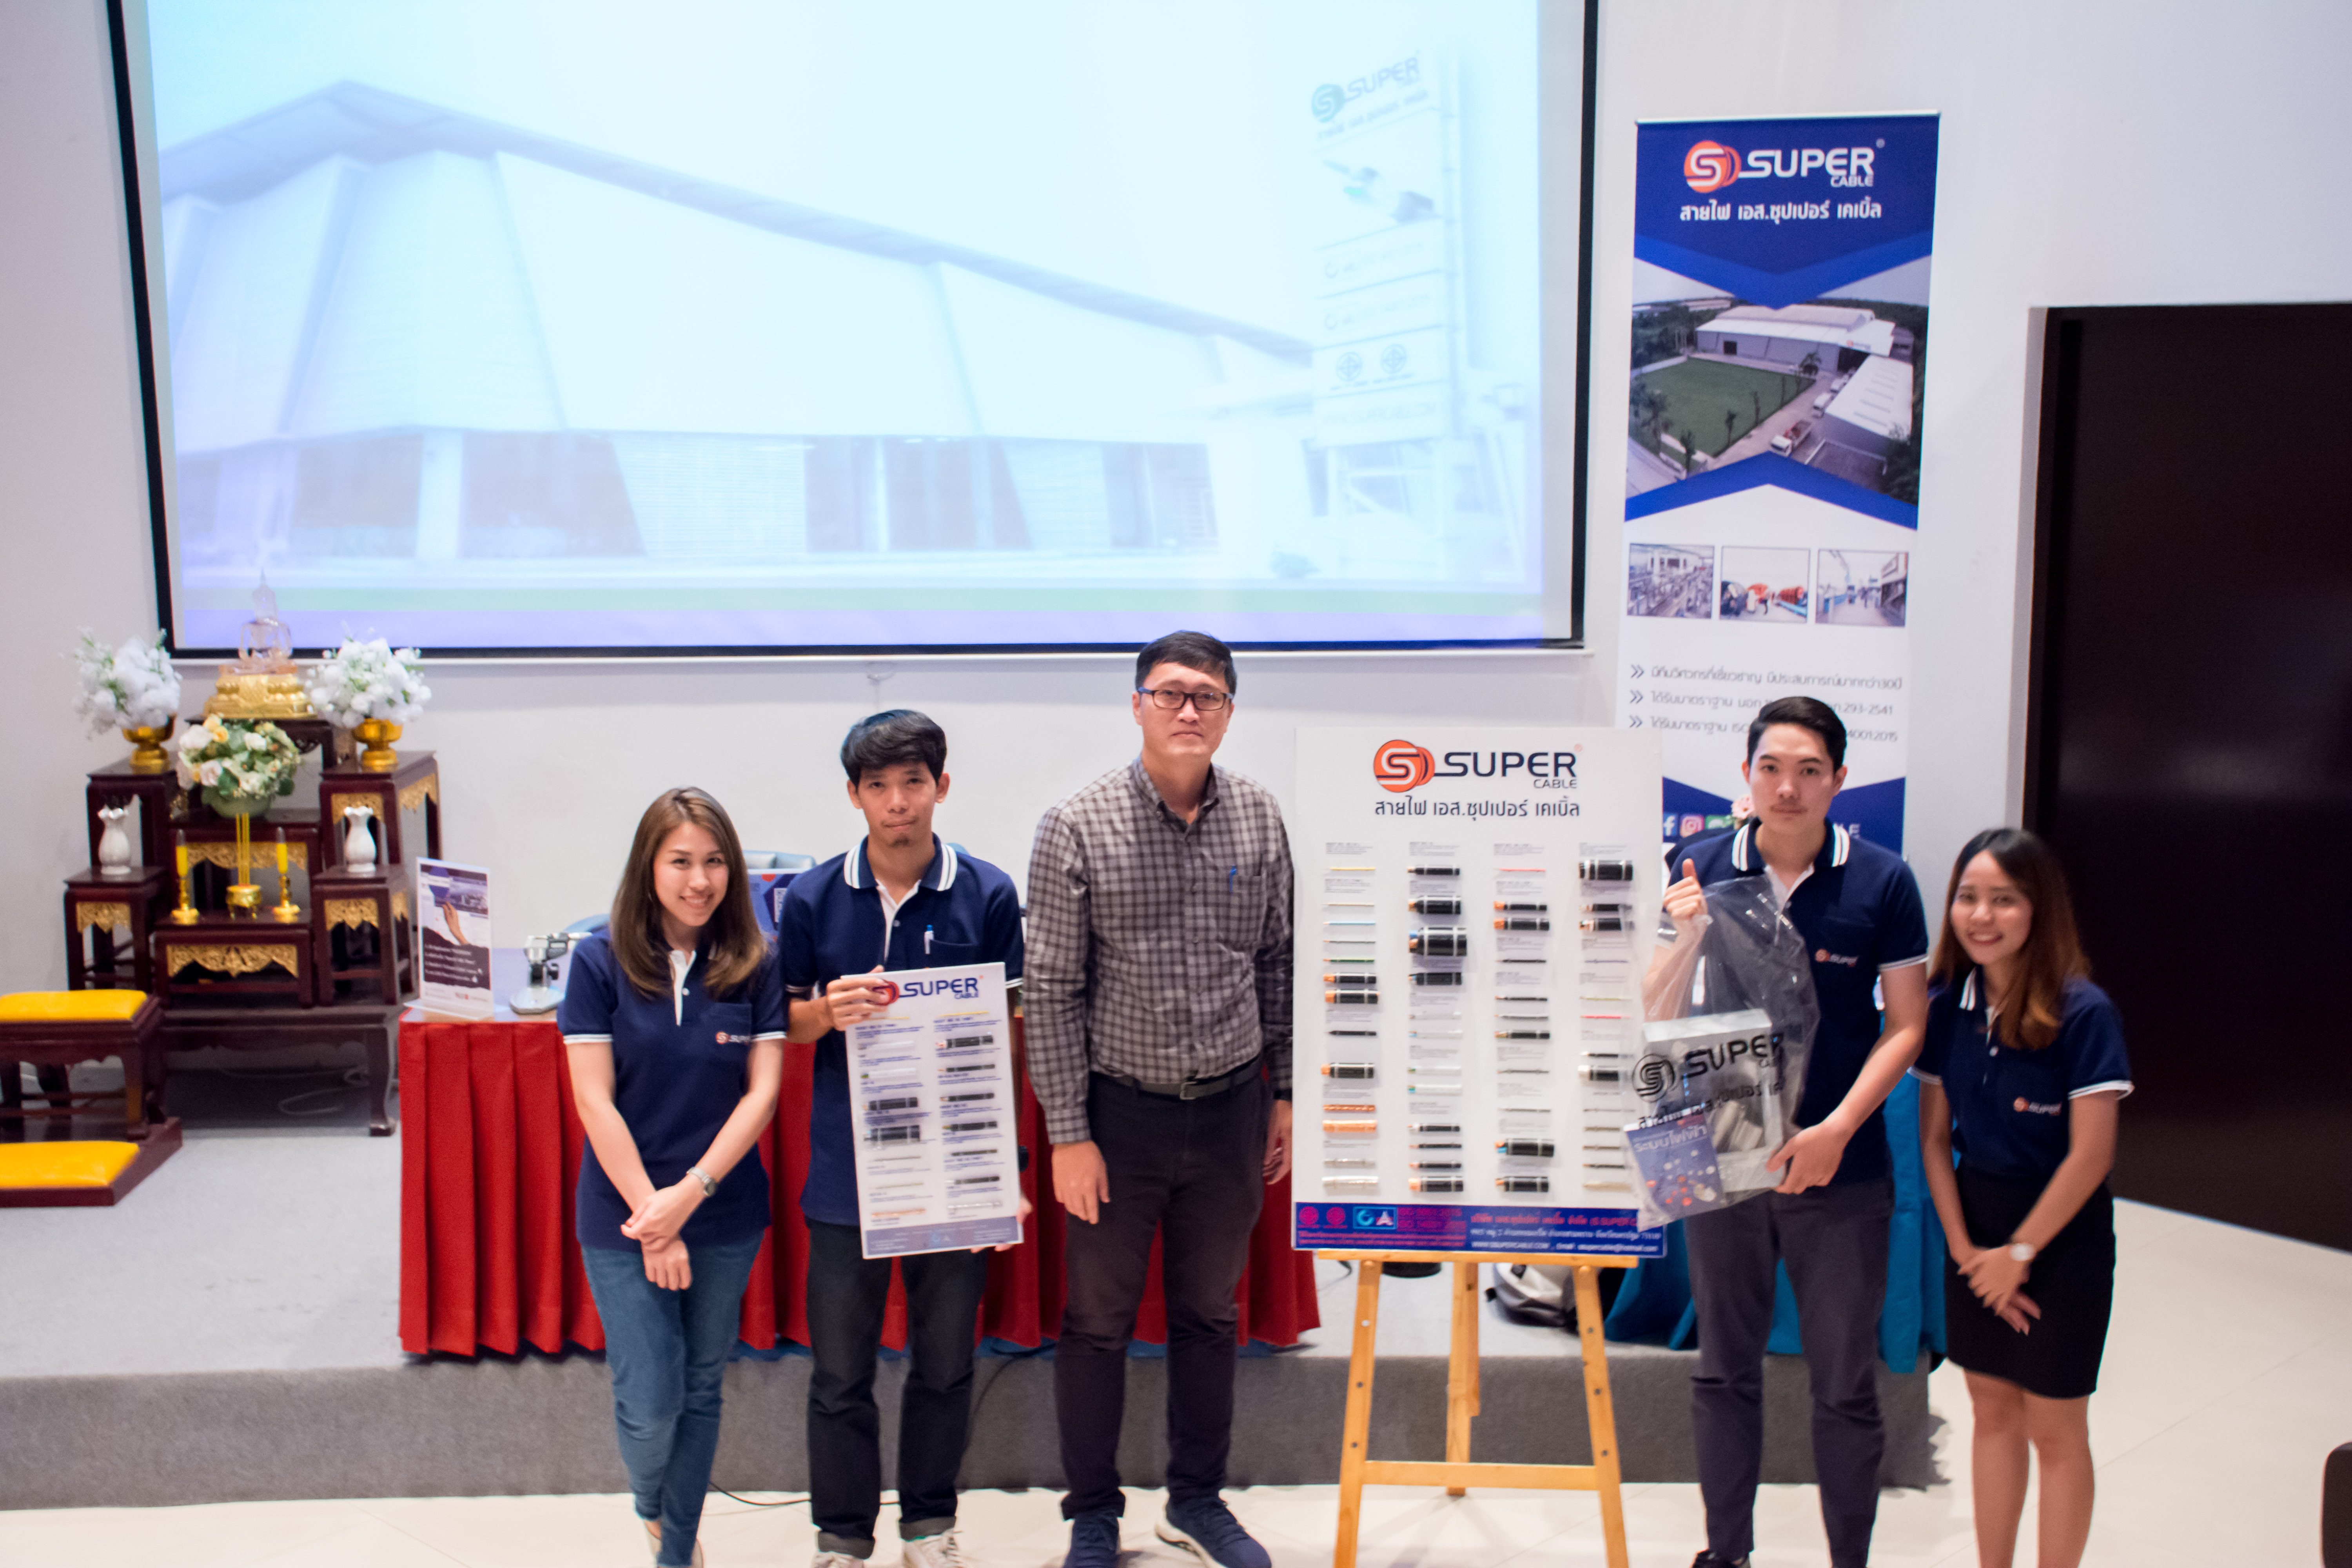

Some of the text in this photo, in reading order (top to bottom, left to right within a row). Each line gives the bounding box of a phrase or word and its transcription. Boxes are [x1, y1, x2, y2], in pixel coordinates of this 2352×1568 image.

[1343, 57, 1420, 103] SUPER
[1738, 147, 1875, 179] SUPER
[1830, 174, 1874, 188] CABLE
[1679, 199, 1731, 221] สายไฟ
[1838, 196, 1882, 219] เคเบิ้ล
[1434, 752, 1576, 777] SUPER
[1533, 779, 1577, 789] CABLE
[1375, 795, 1427, 816] สายไฟ
[1535, 796, 1580, 817] เคเบิ้ล
[899, 977, 979, 998] SUPER
